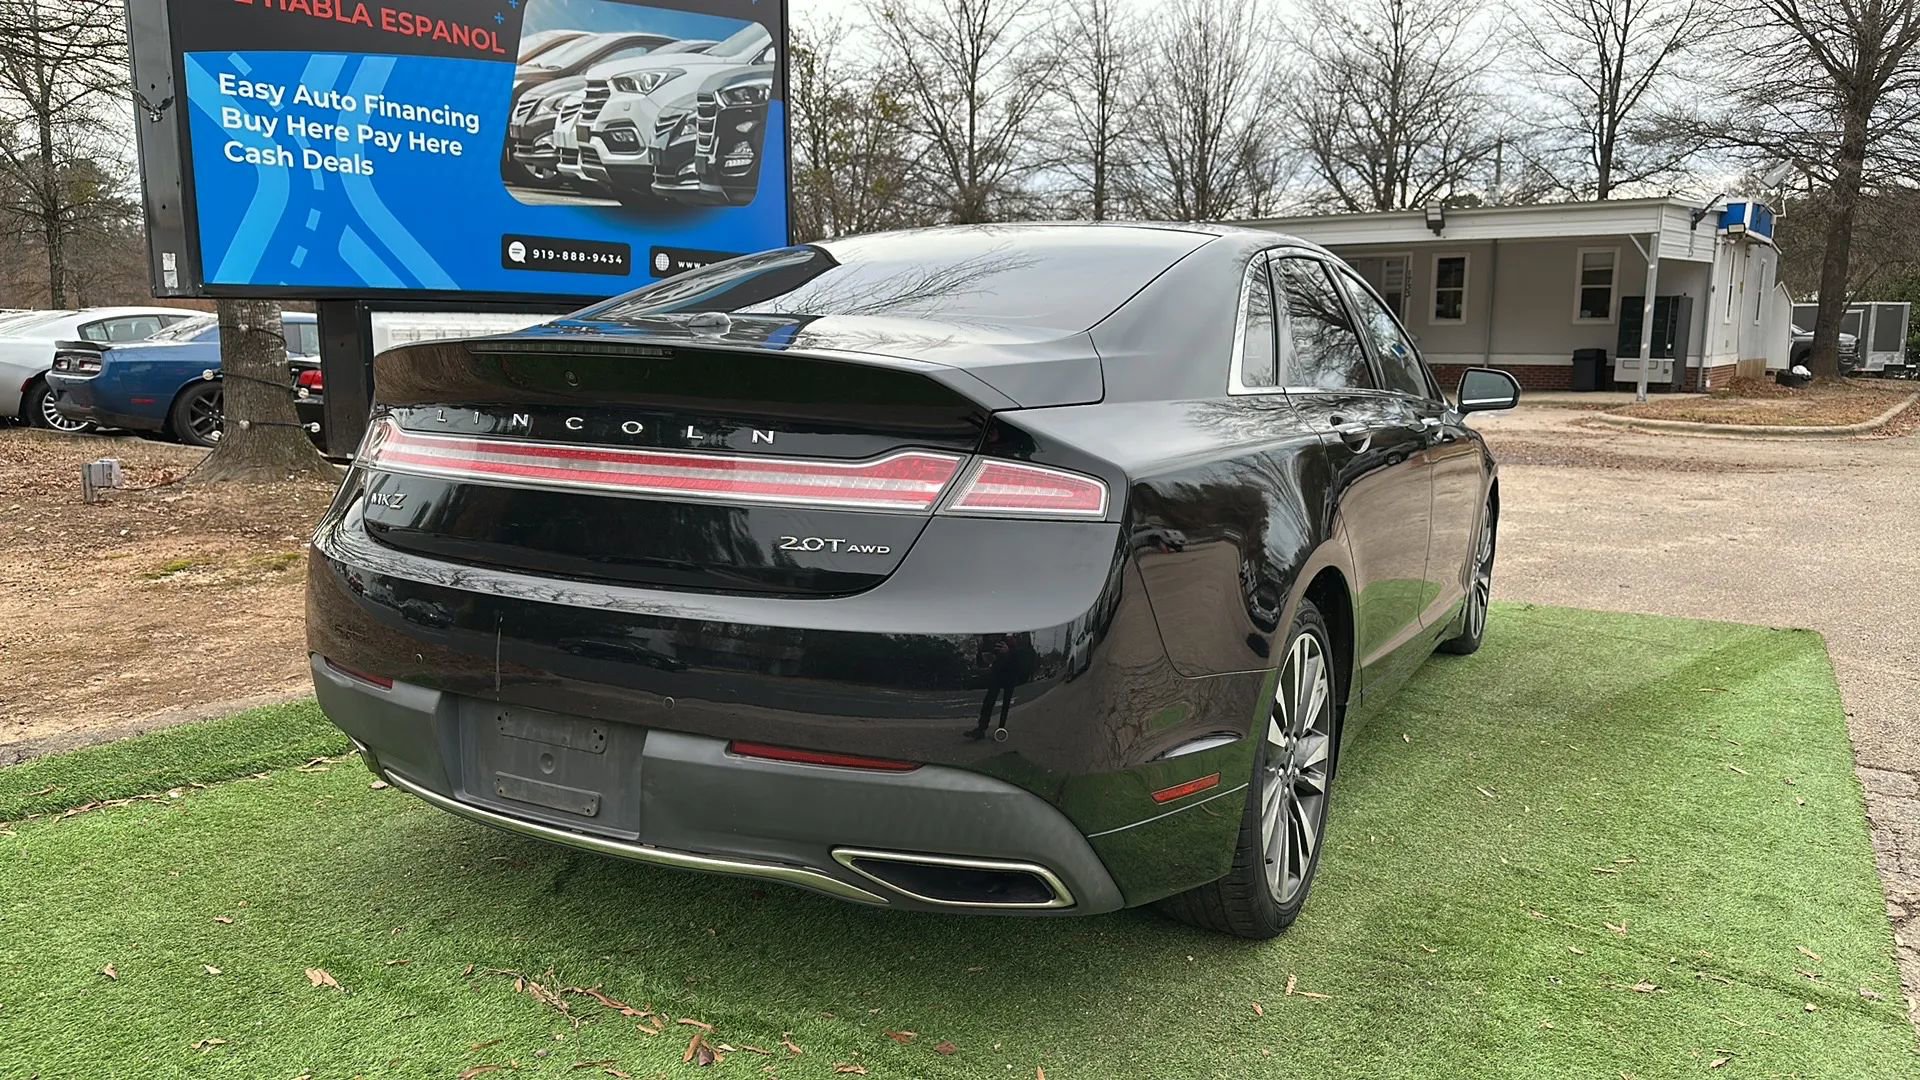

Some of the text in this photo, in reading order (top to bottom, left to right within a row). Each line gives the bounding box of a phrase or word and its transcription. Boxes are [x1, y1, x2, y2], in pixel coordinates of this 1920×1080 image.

[381, 7, 505, 54] ESPANOL
[218, 72, 480, 133] Easy Auto Financing
[221, 106, 463, 156] Buy Here Pay Here
[224, 141, 374, 175] Cash Deals
[533, 249, 623, 264] 919-888-9434
[436, 409, 775, 444] LINCOLN
[371, 492, 407, 510] MKZ
[847, 544, 890, 554] AWD
